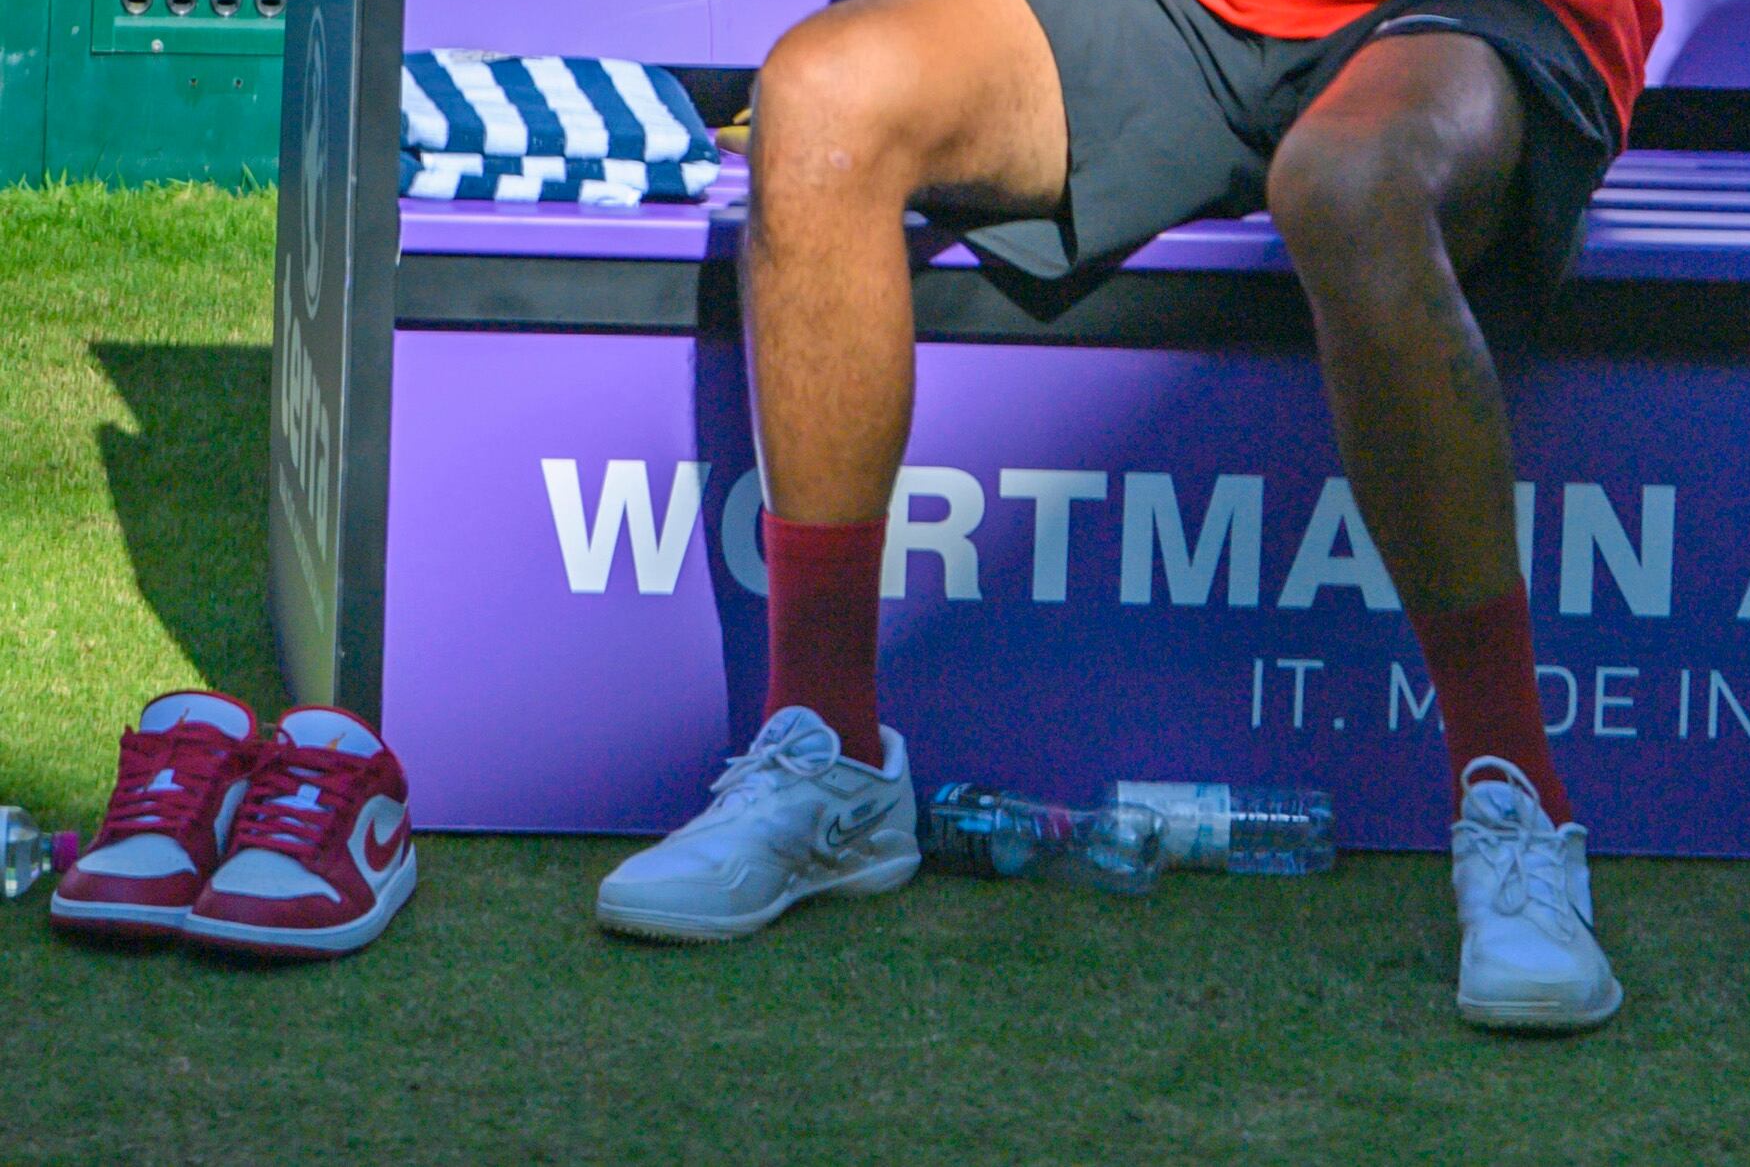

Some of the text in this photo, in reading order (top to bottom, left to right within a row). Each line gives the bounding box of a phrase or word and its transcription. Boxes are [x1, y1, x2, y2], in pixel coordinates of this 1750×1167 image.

[541, 457, 1676, 618] WRTMAN
[1251, 657, 1345, 731] IT.
[1388, 660, 1641, 739] MDE
